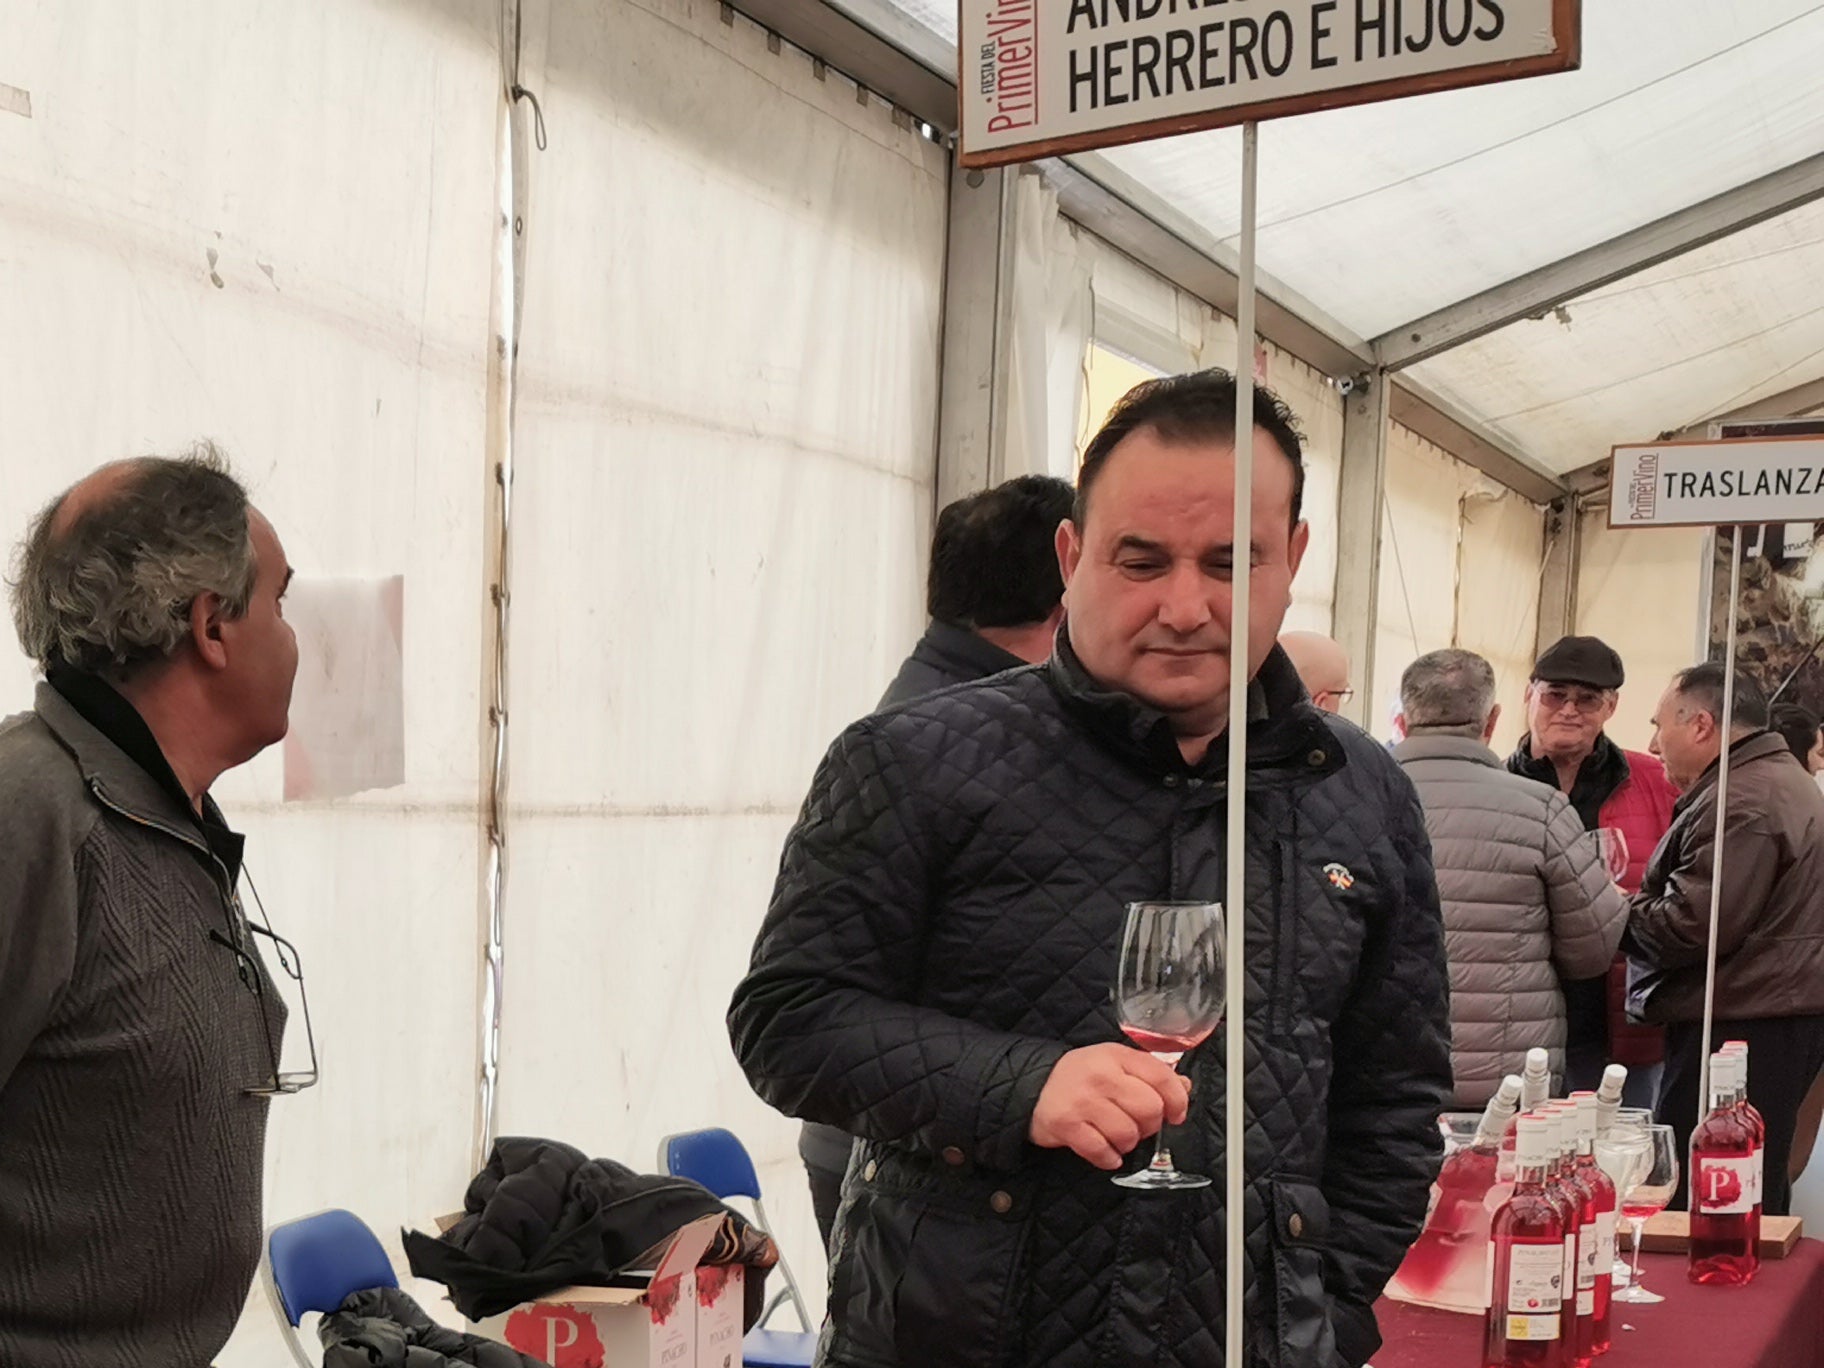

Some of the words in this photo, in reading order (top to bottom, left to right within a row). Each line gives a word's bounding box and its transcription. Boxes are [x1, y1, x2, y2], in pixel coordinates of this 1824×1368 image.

[1069, 10, 1294, 113] HERRERO
[1311, 1, 1338, 69] E
[1355, 0, 1505, 62] HIJOS
[1708, 1171, 1730, 1201] P
[541, 1316, 579, 1368] P
